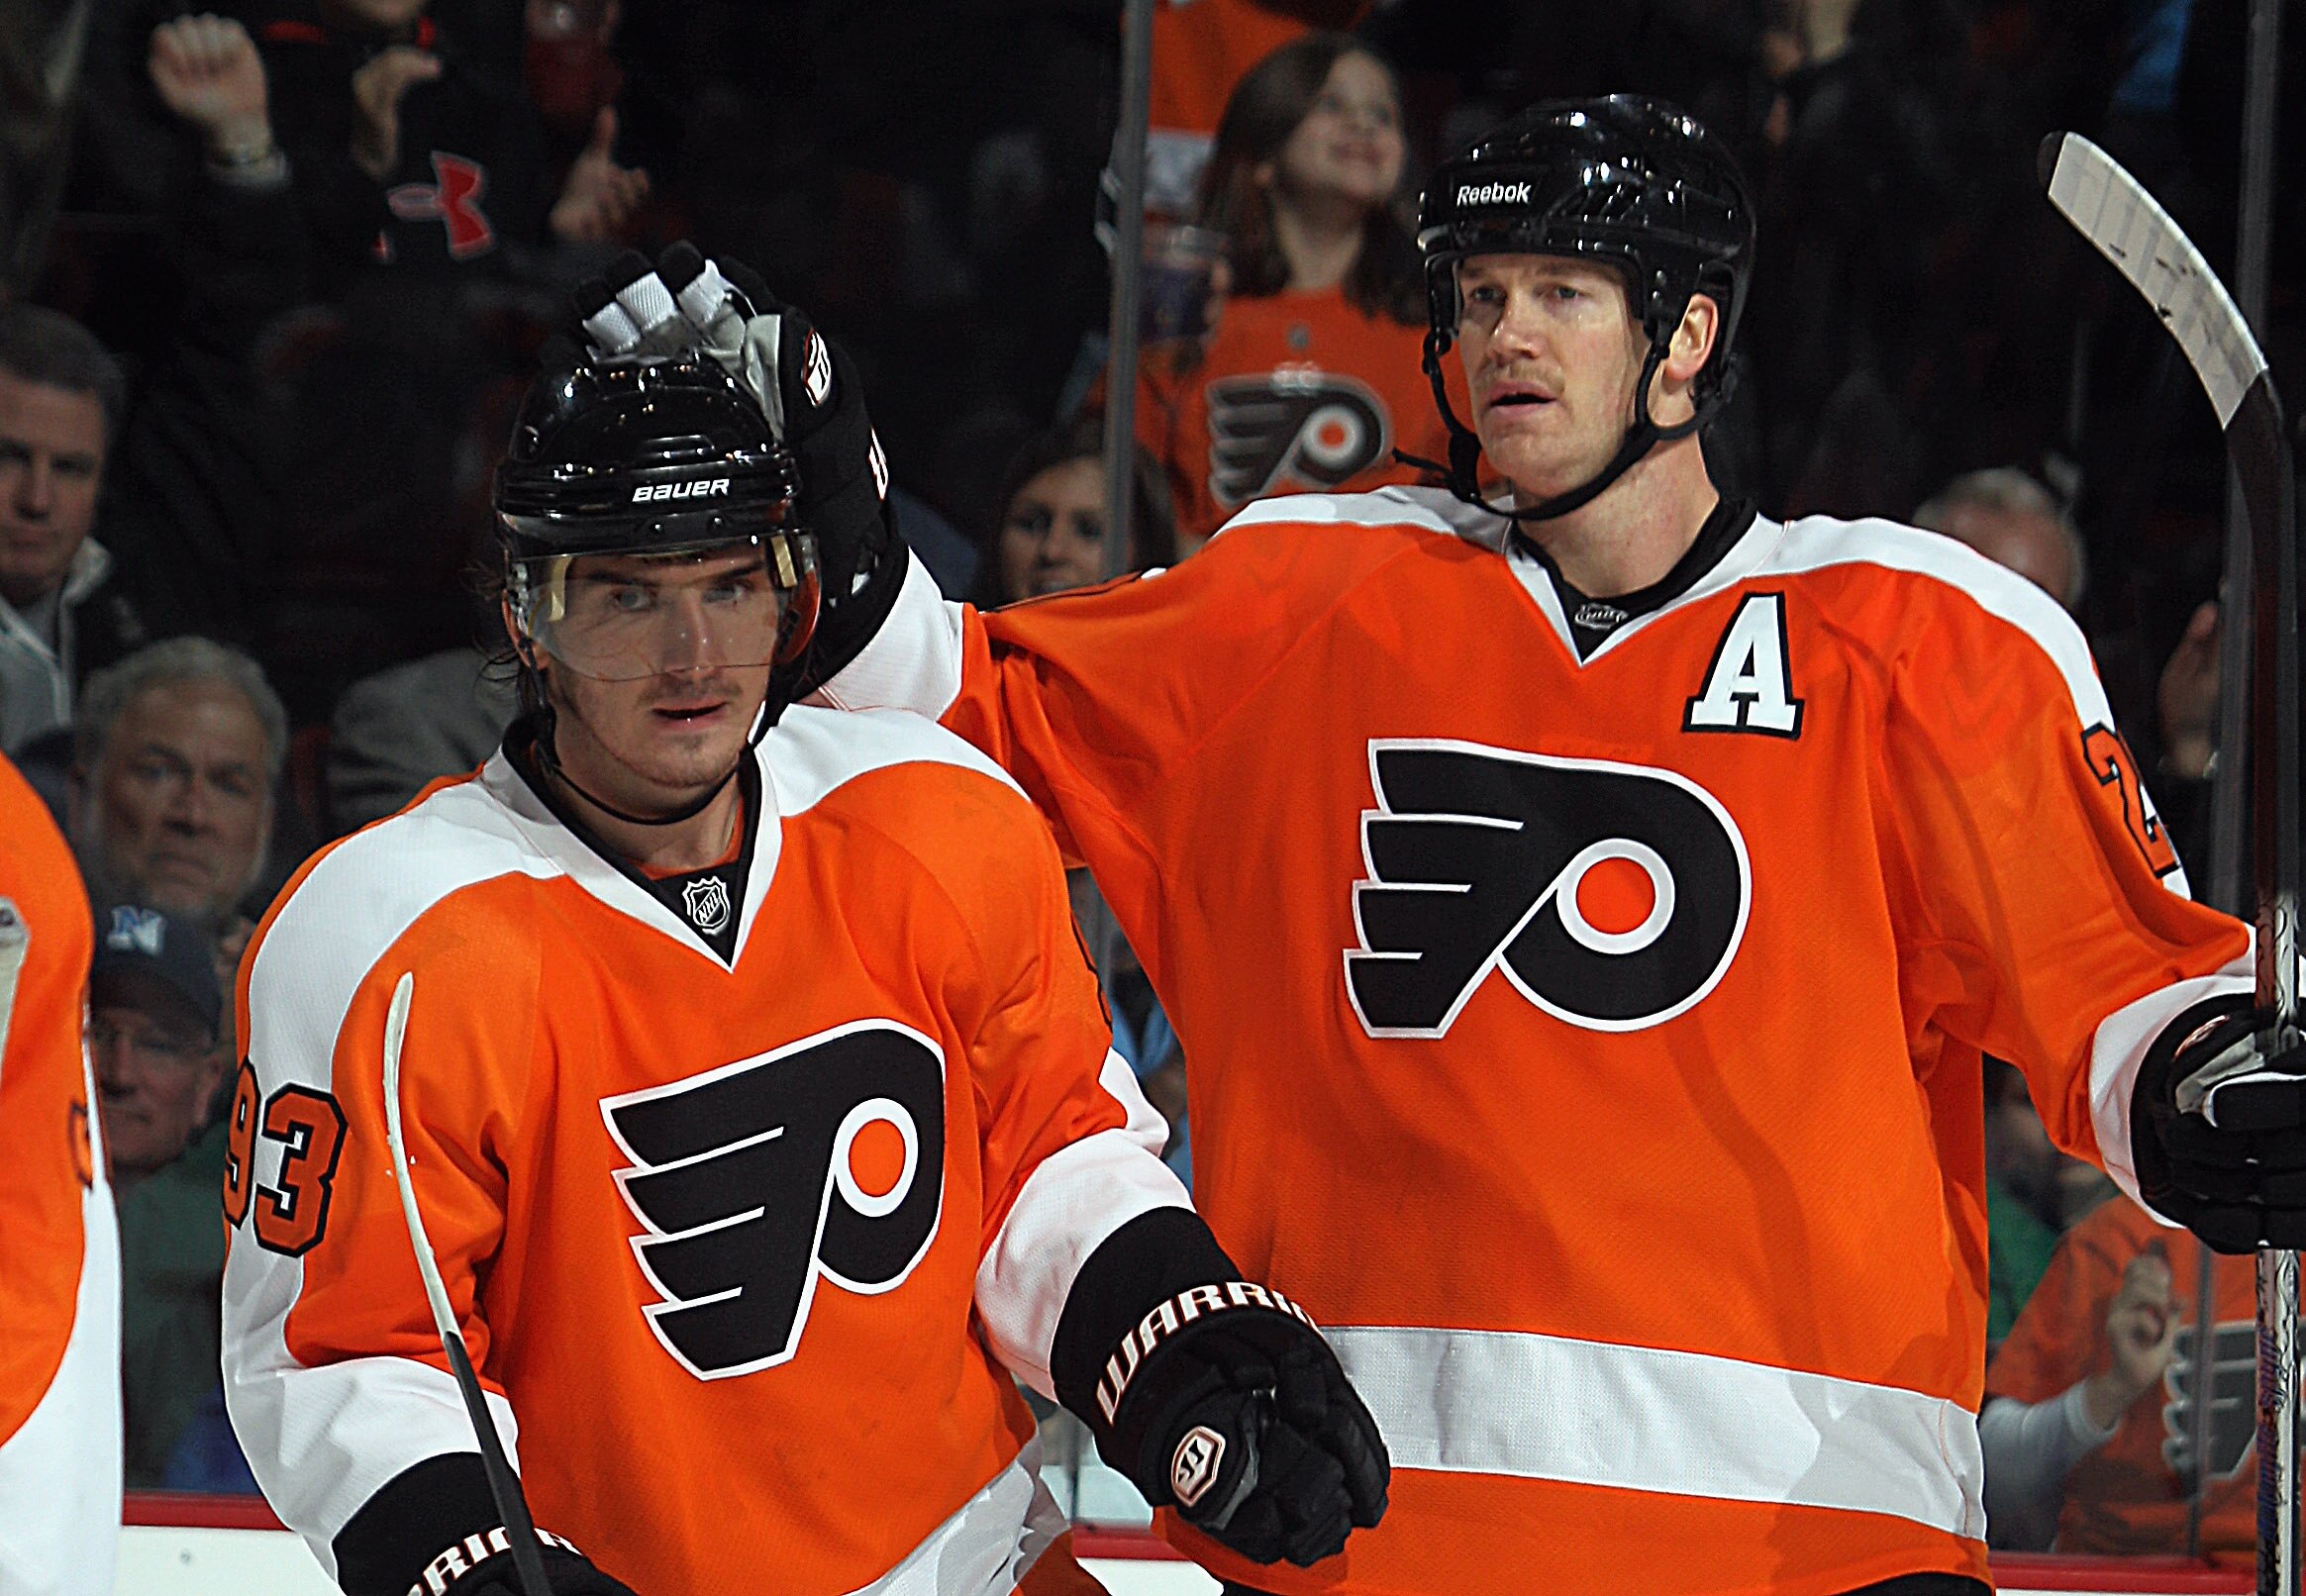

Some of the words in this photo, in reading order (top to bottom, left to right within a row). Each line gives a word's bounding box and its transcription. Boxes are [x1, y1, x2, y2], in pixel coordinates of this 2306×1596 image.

[1456, 181, 1532, 207] Reebok
[632, 478, 730, 503] BAUER
[1682, 591, 1805, 741] A
[106, 904, 166, 955] N
[222, 1055, 349, 1258] 93
